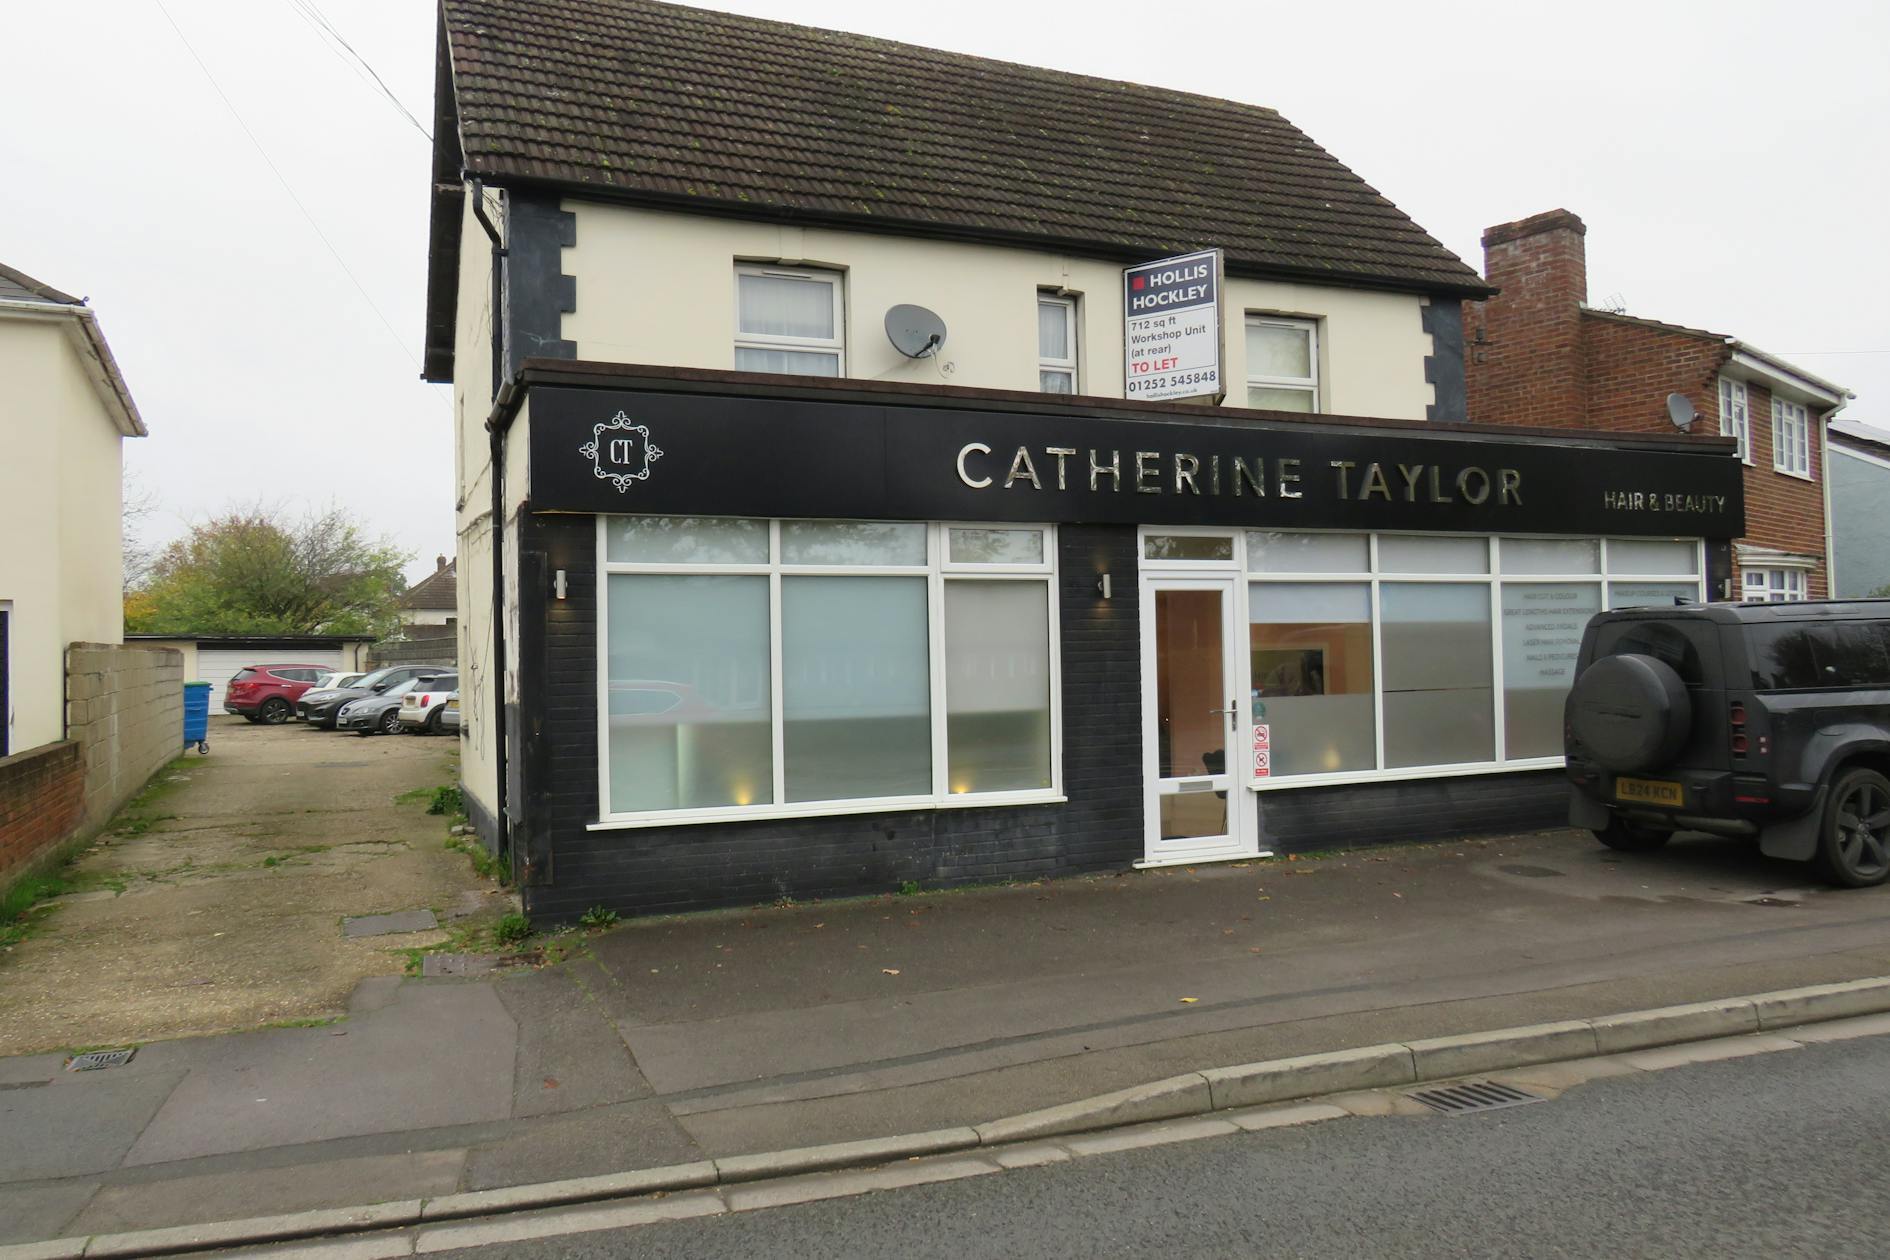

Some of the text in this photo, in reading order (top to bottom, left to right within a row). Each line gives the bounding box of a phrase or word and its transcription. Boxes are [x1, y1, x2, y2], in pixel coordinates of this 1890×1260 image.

[1150, 265, 1208, 288] HOLLIS
[1133, 284, 1208, 310] HOCKLEY
[1131, 316, 1176, 331] 712 sq ft
[1131, 325, 1206, 344] Workshop Unit
[1131, 344, 1171, 359] (at rear)
[1132, 357, 1179, 374] TO LET
[1129, 370, 1217, 393] 01252 545848
[610, 439, 633, 465] CT
[956, 442, 1523, 506] CATHERINE TAYLOR
[1604, 491, 1725, 512] HAIR & BEAUTY
